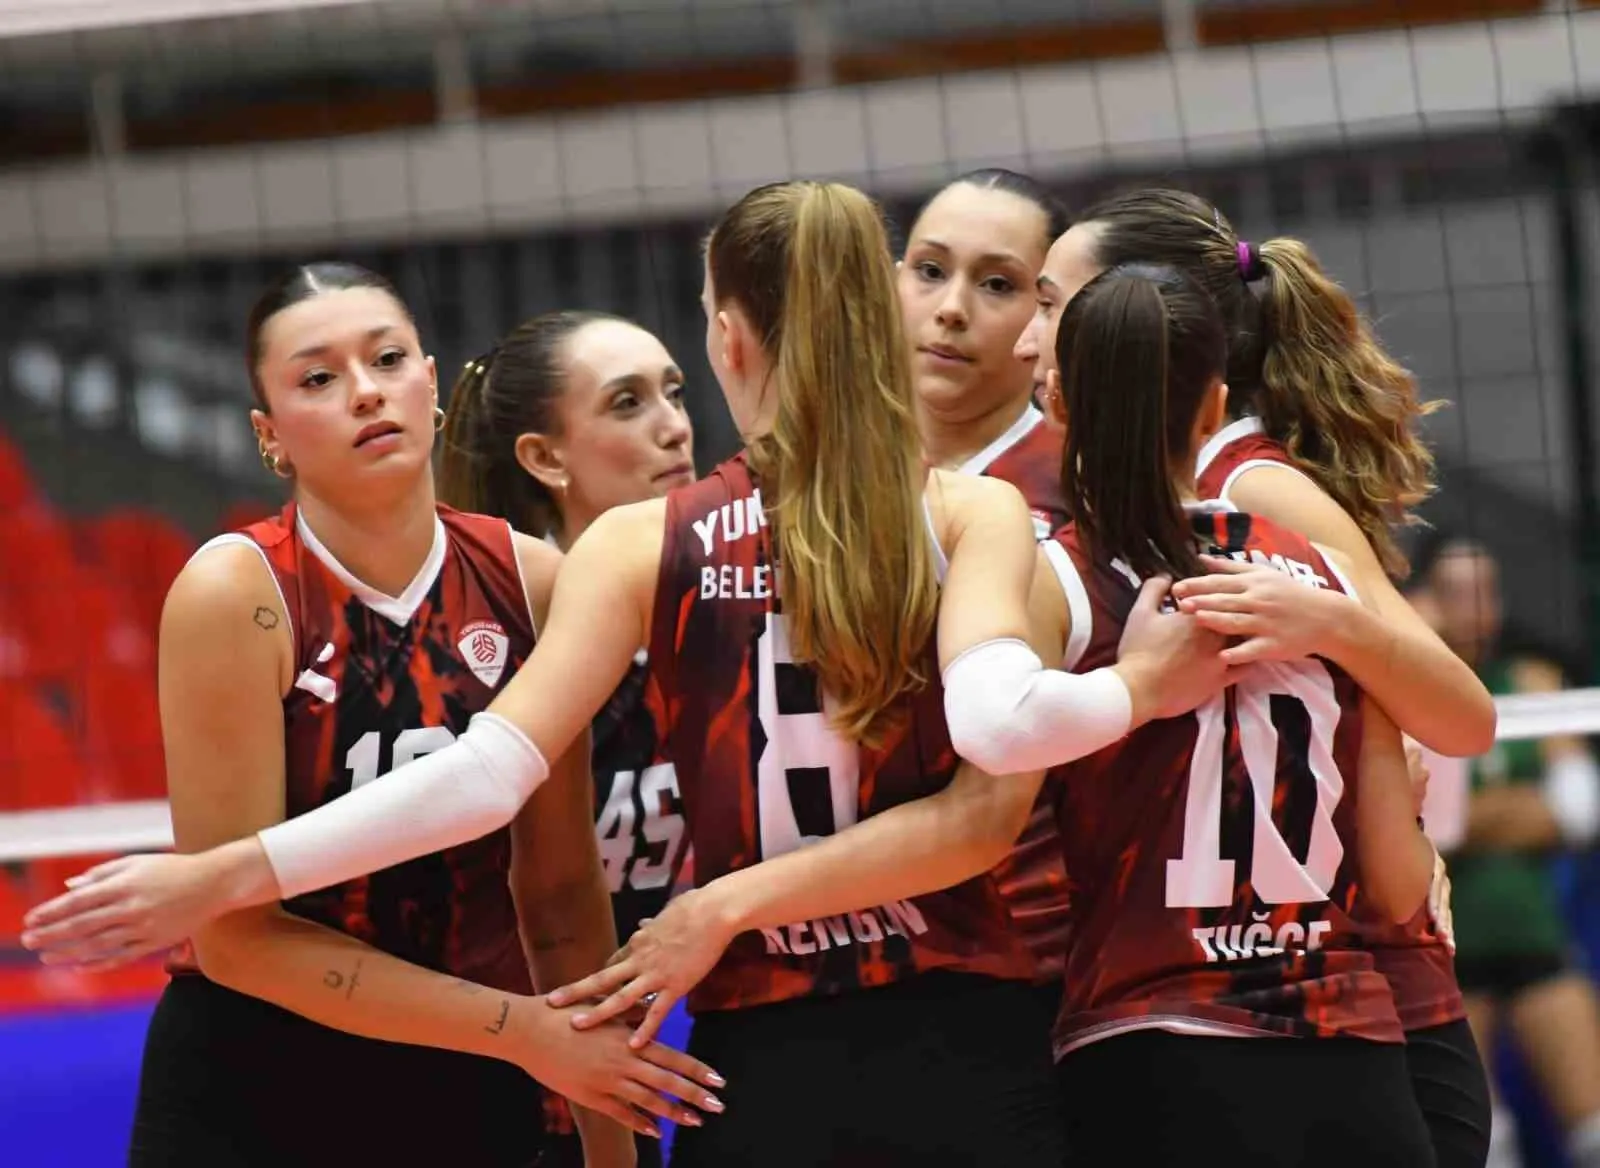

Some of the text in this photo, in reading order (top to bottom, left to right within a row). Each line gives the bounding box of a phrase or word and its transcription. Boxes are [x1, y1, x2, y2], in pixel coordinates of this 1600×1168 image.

[592, 762, 685, 894] 45
[758, 611, 860, 863] 8
[1165, 654, 1345, 908] 10
